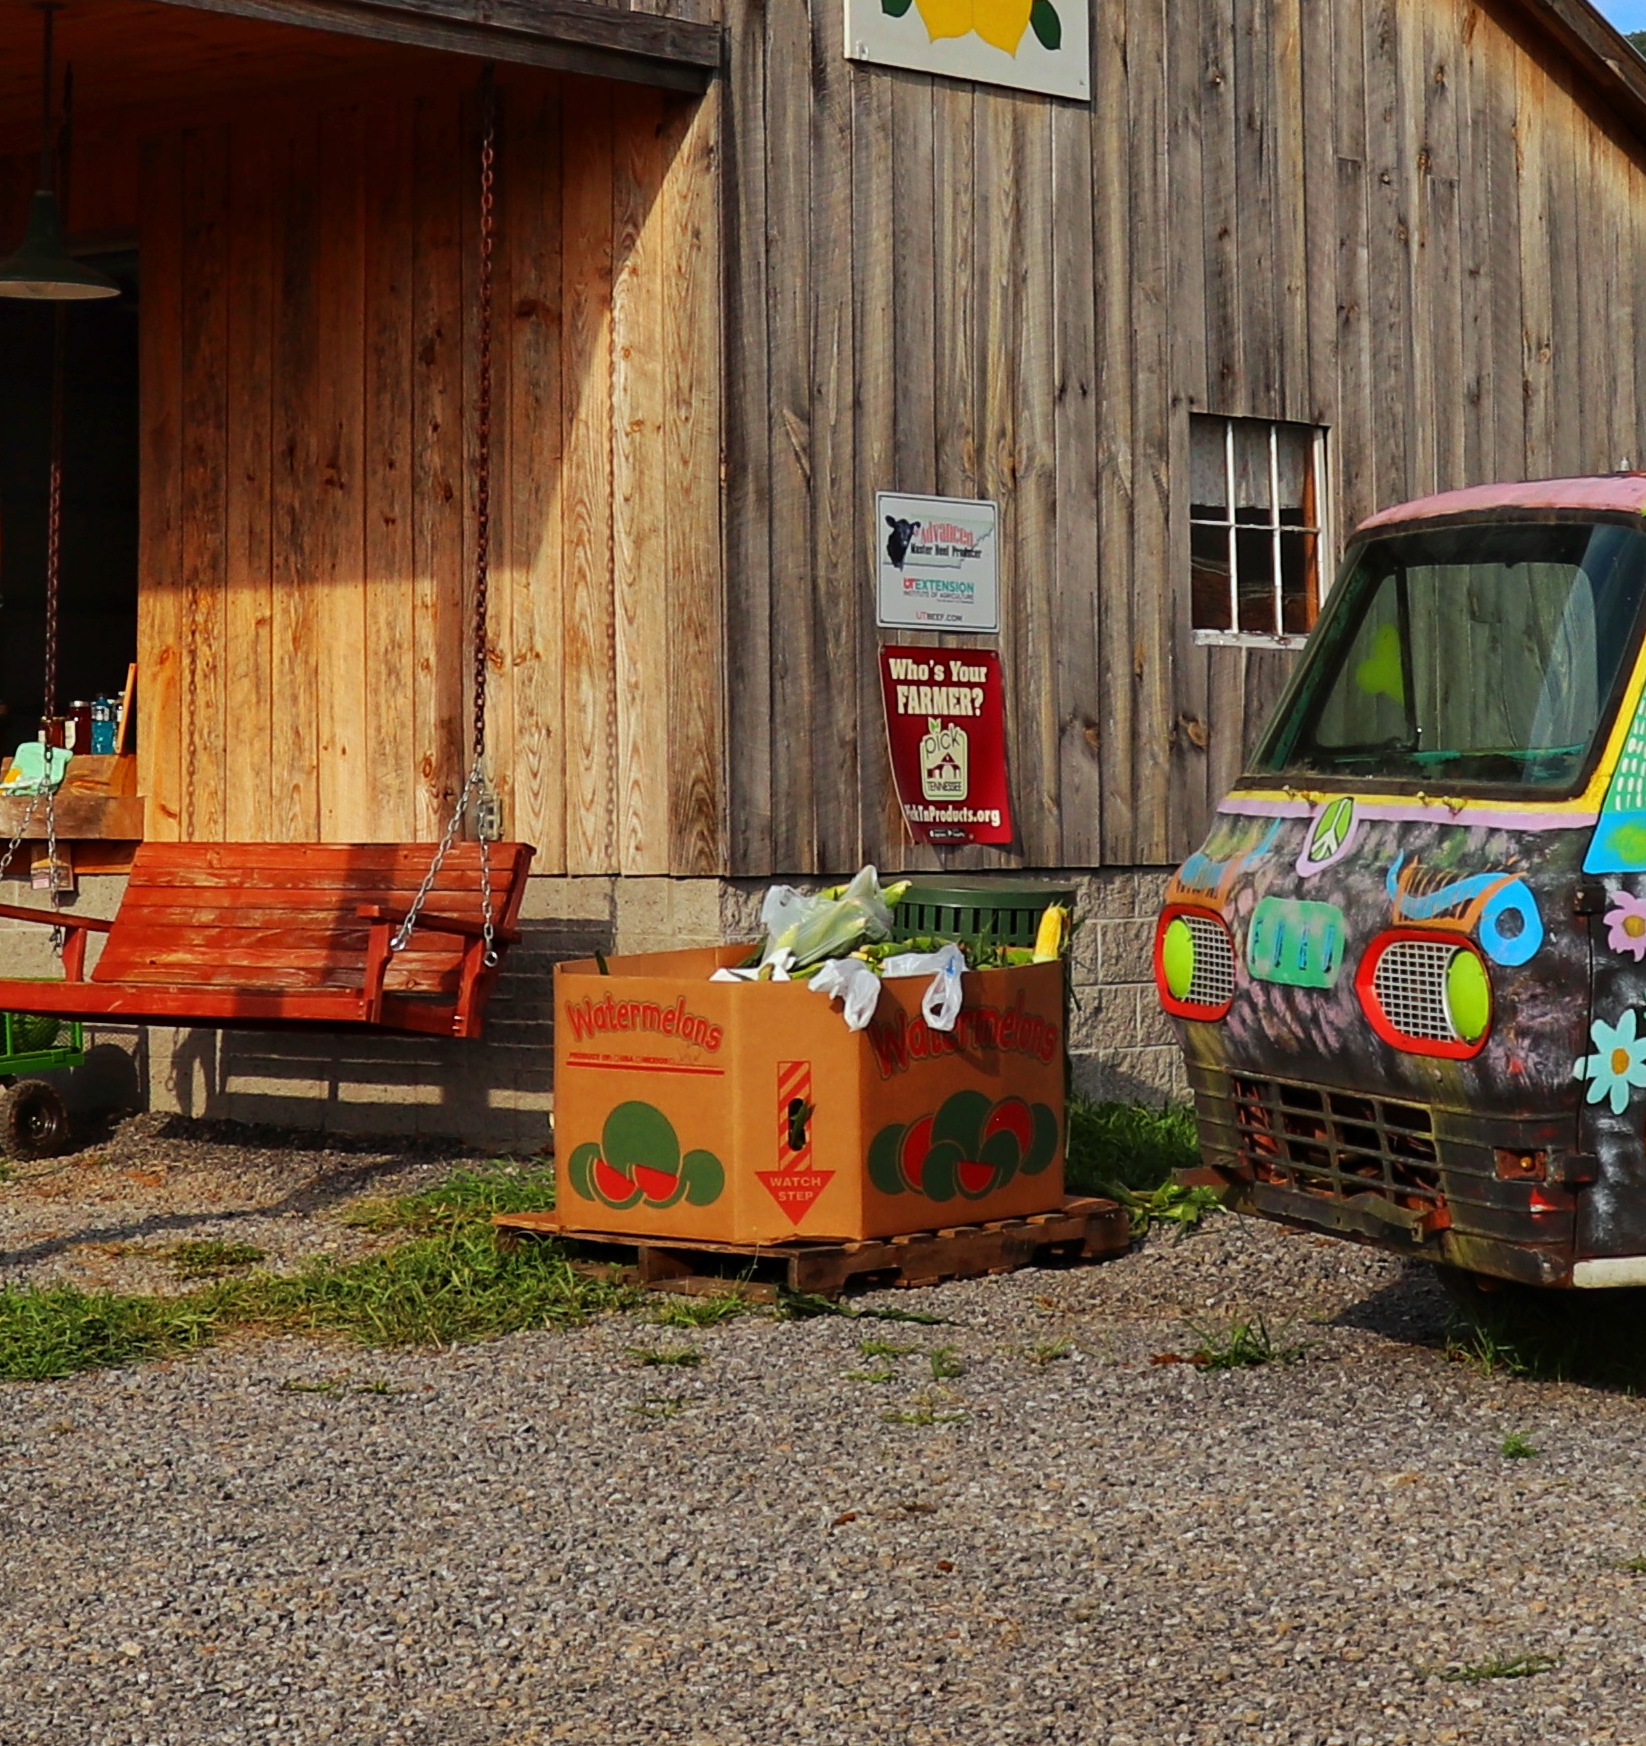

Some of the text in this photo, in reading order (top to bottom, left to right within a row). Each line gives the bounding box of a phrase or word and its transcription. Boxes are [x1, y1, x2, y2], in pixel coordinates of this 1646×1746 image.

[888, 657, 988, 683] Who's Your
[896, 685, 984, 716] FARMER?
[925, 726, 960, 760] pick
[926, 780, 962, 792] TENNESSEE
[566, 991, 724, 1053] Watermelons
[770, 1177, 822, 1187] WATCH
[778, 1191, 813, 1202] STEP
